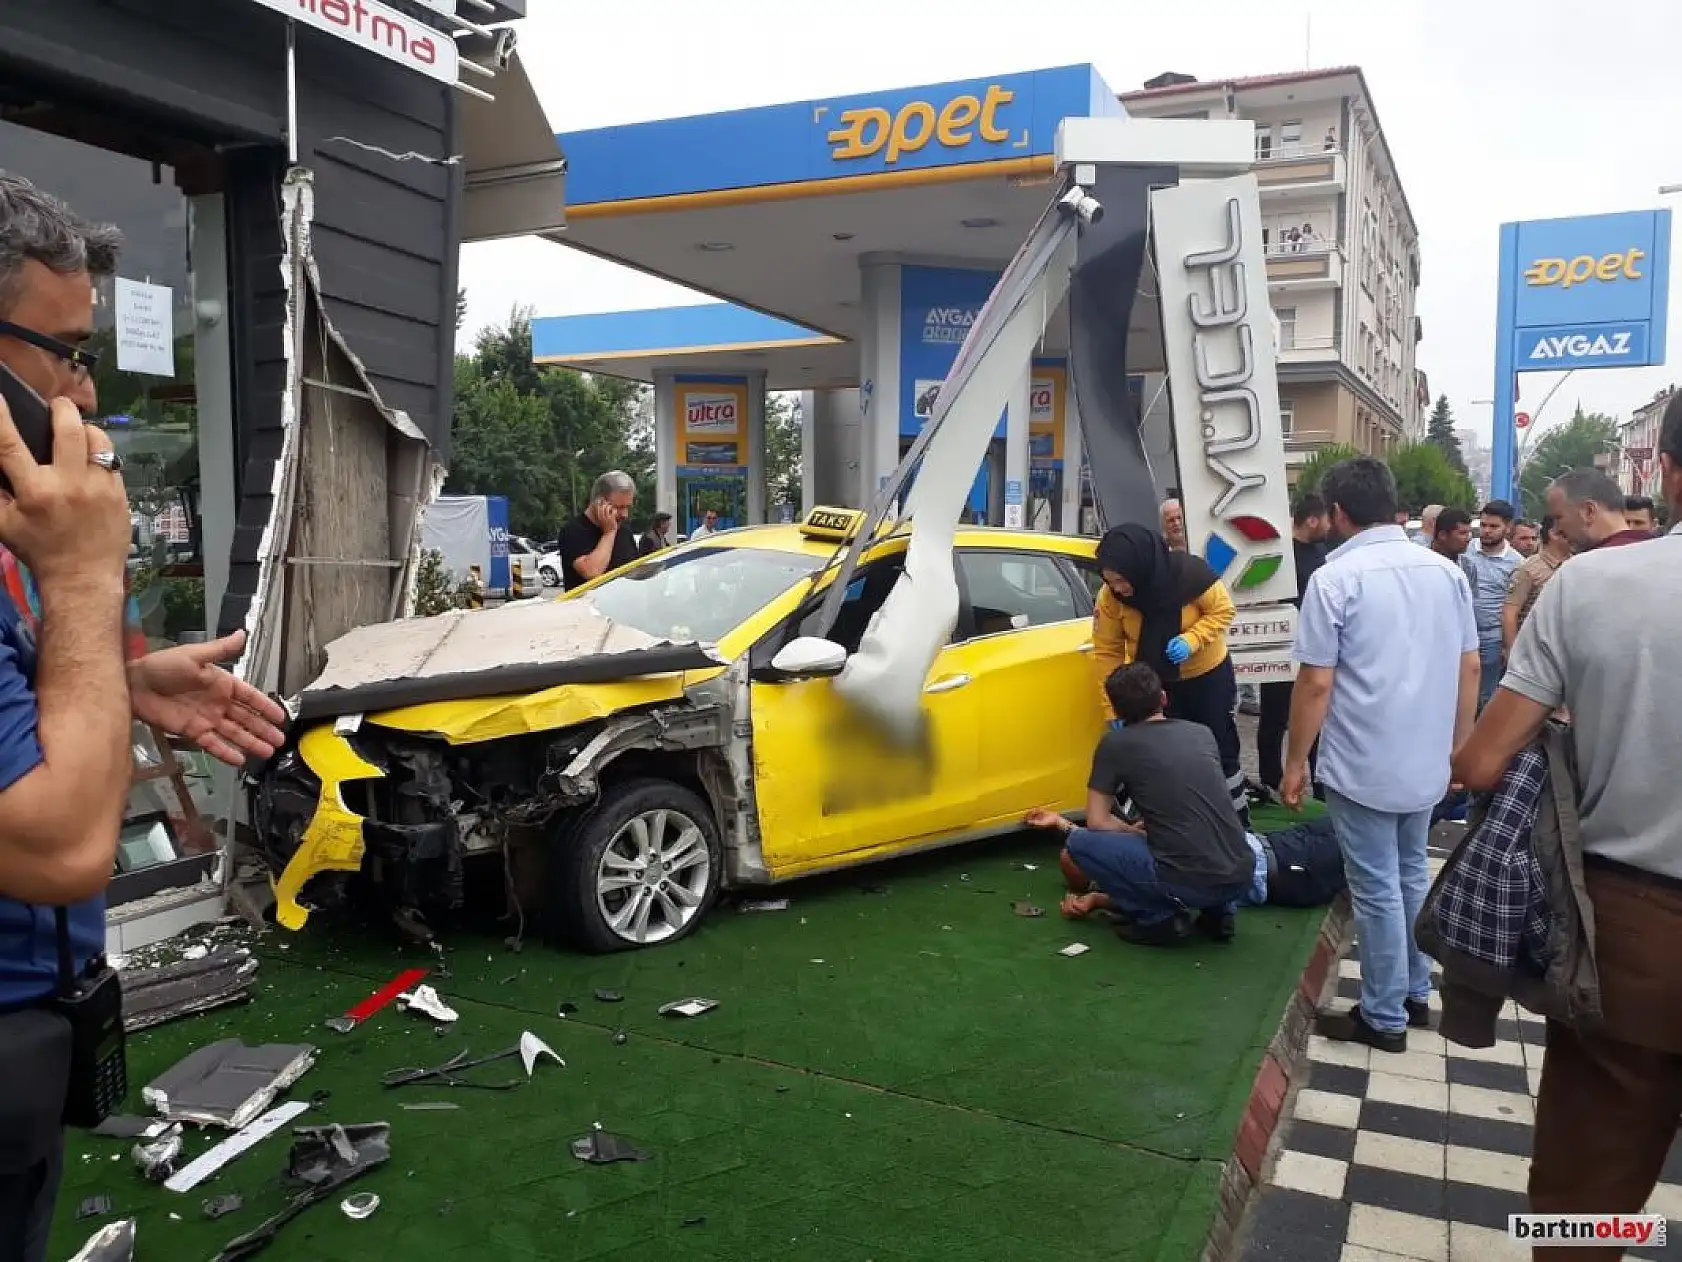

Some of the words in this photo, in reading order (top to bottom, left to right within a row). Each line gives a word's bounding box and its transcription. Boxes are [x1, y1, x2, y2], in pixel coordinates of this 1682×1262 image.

[827, 84, 1014, 164] opet
[1524, 247, 1645, 288] opet
[925, 307, 985, 326] AYGA
[1529, 331, 1633, 359] AYGAZ
[689, 403, 734, 423] ultra
